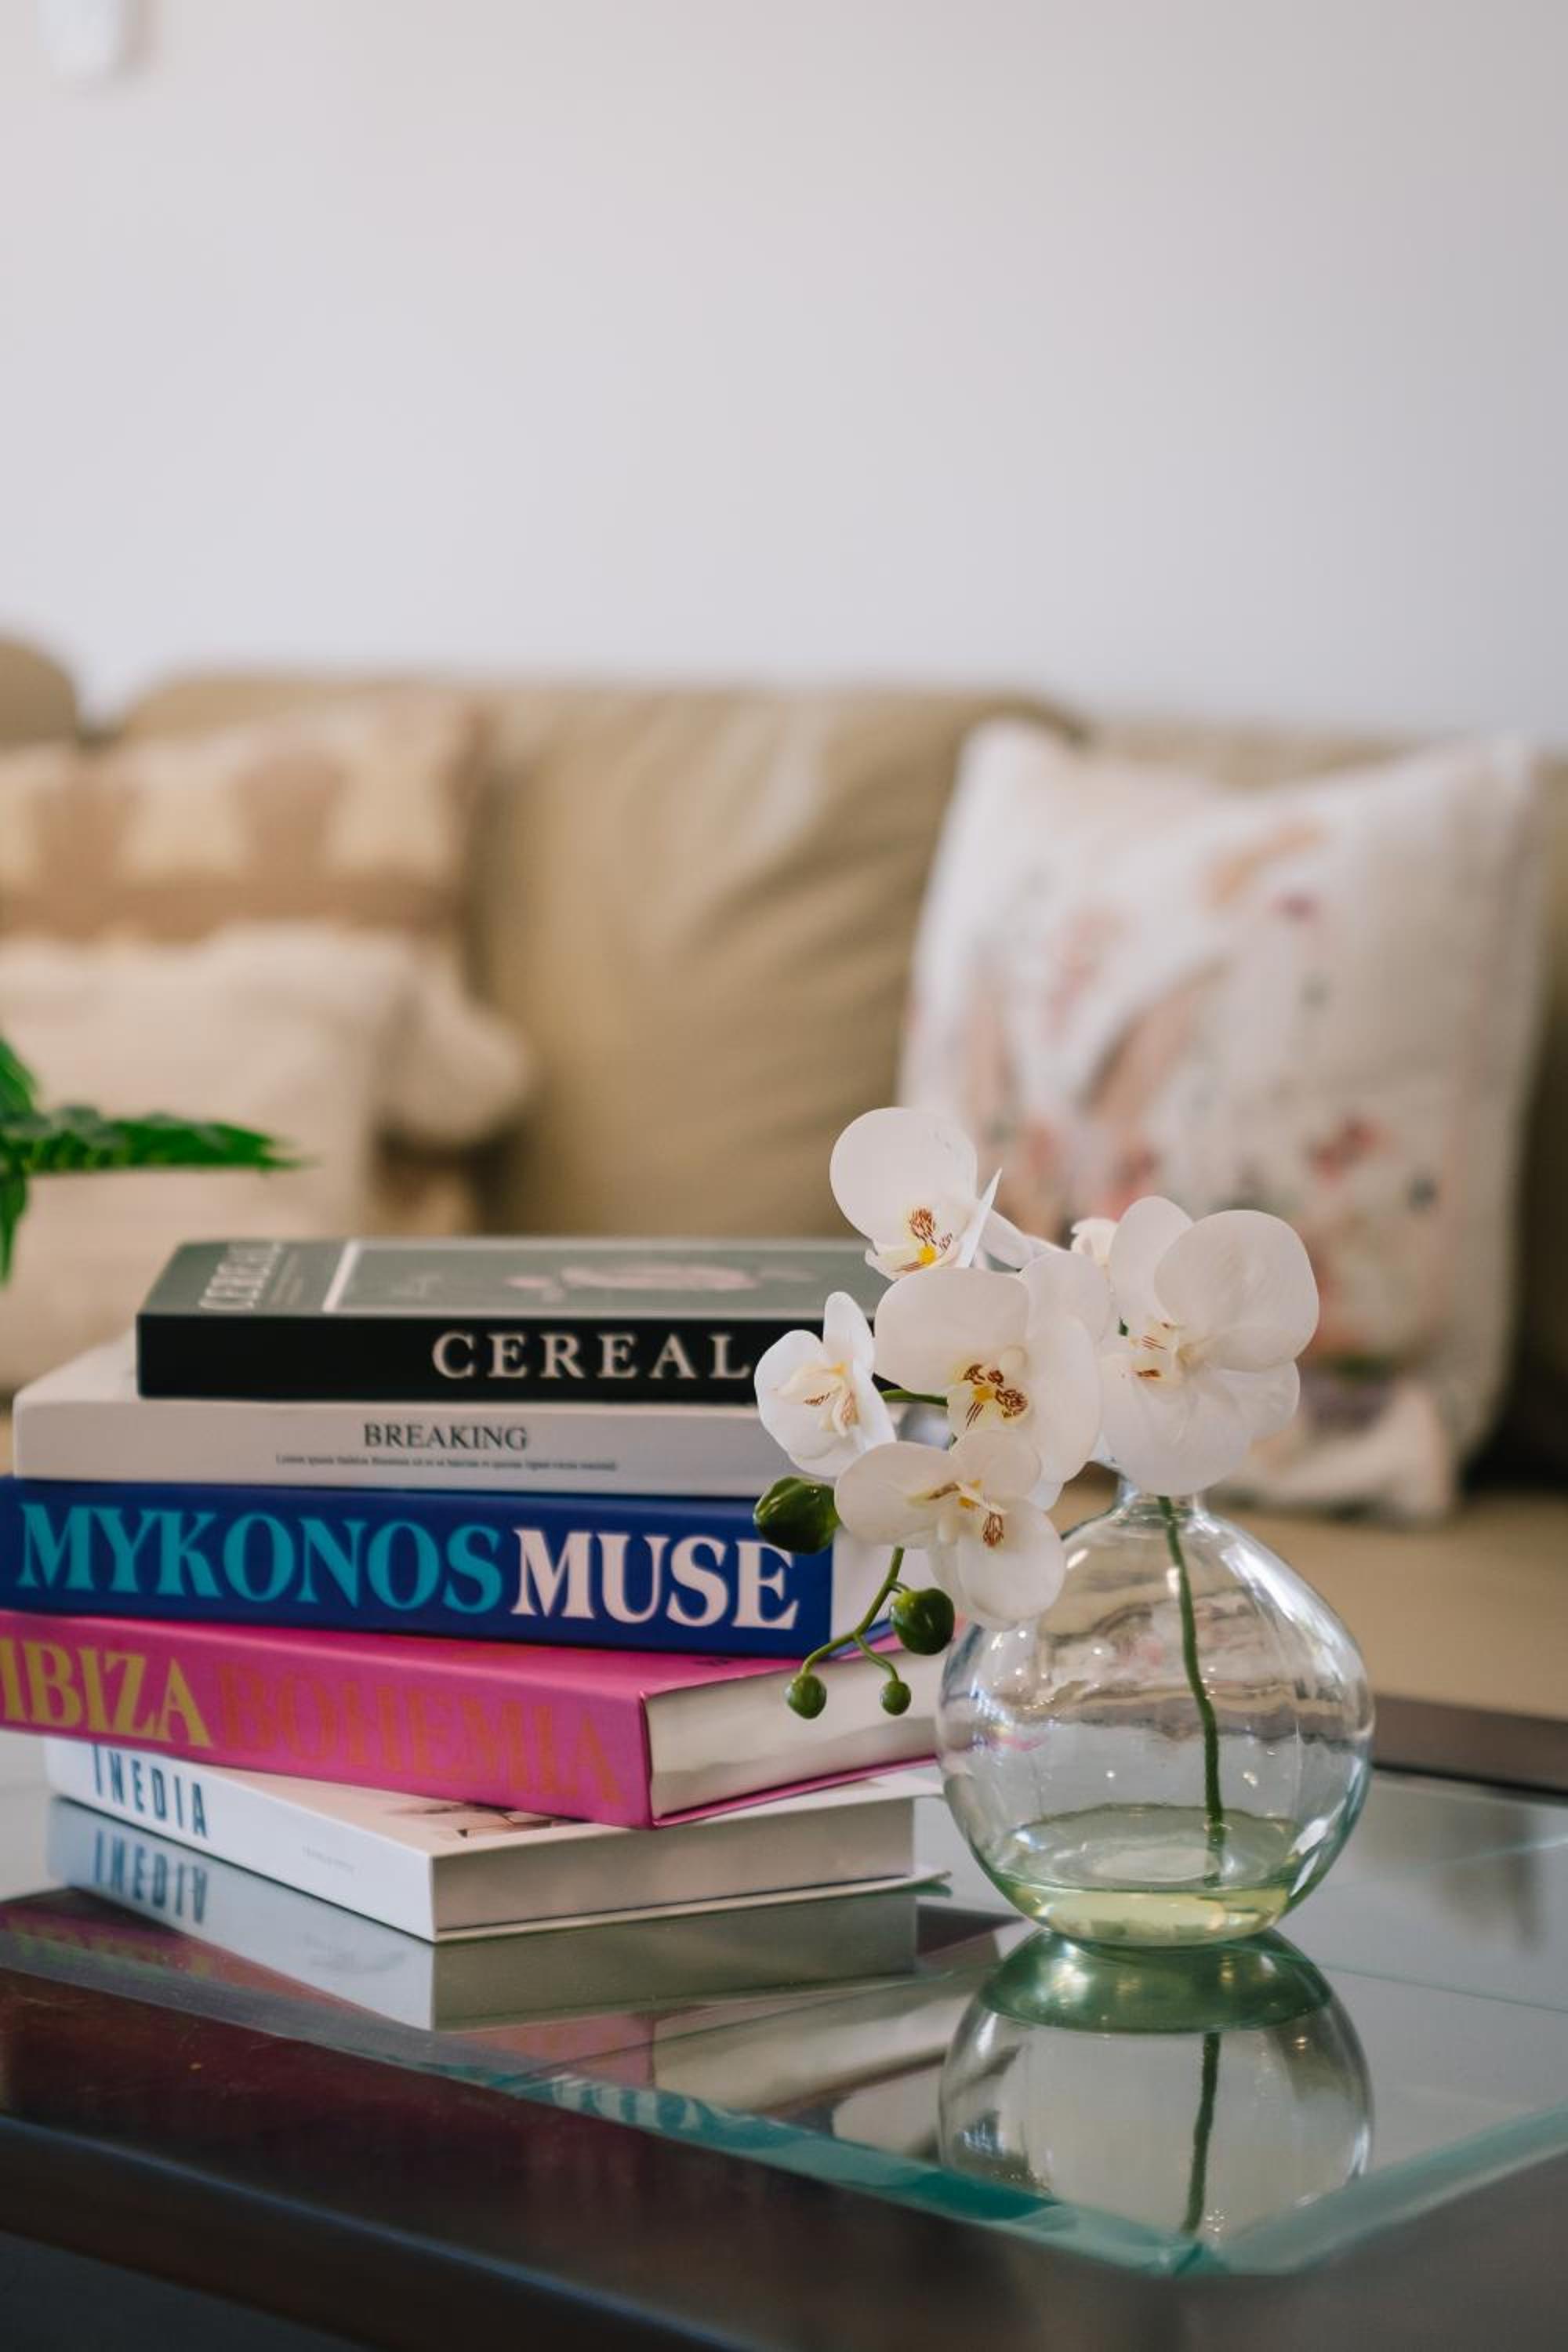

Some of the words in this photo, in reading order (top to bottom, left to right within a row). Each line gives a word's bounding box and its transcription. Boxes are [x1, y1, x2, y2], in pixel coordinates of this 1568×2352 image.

[432, 1332, 751, 1379] CEREAL
[363, 1423, 528, 1450] BREAKING
[18, 1502, 503, 1613] MYKONOS
[510, 1529, 799, 1630] MUSE
[0, 1637, 212, 1748] IBIZA
[216, 1663, 622, 1802] BOHEMIA
[93, 1744, 209, 1838] INEDIA
